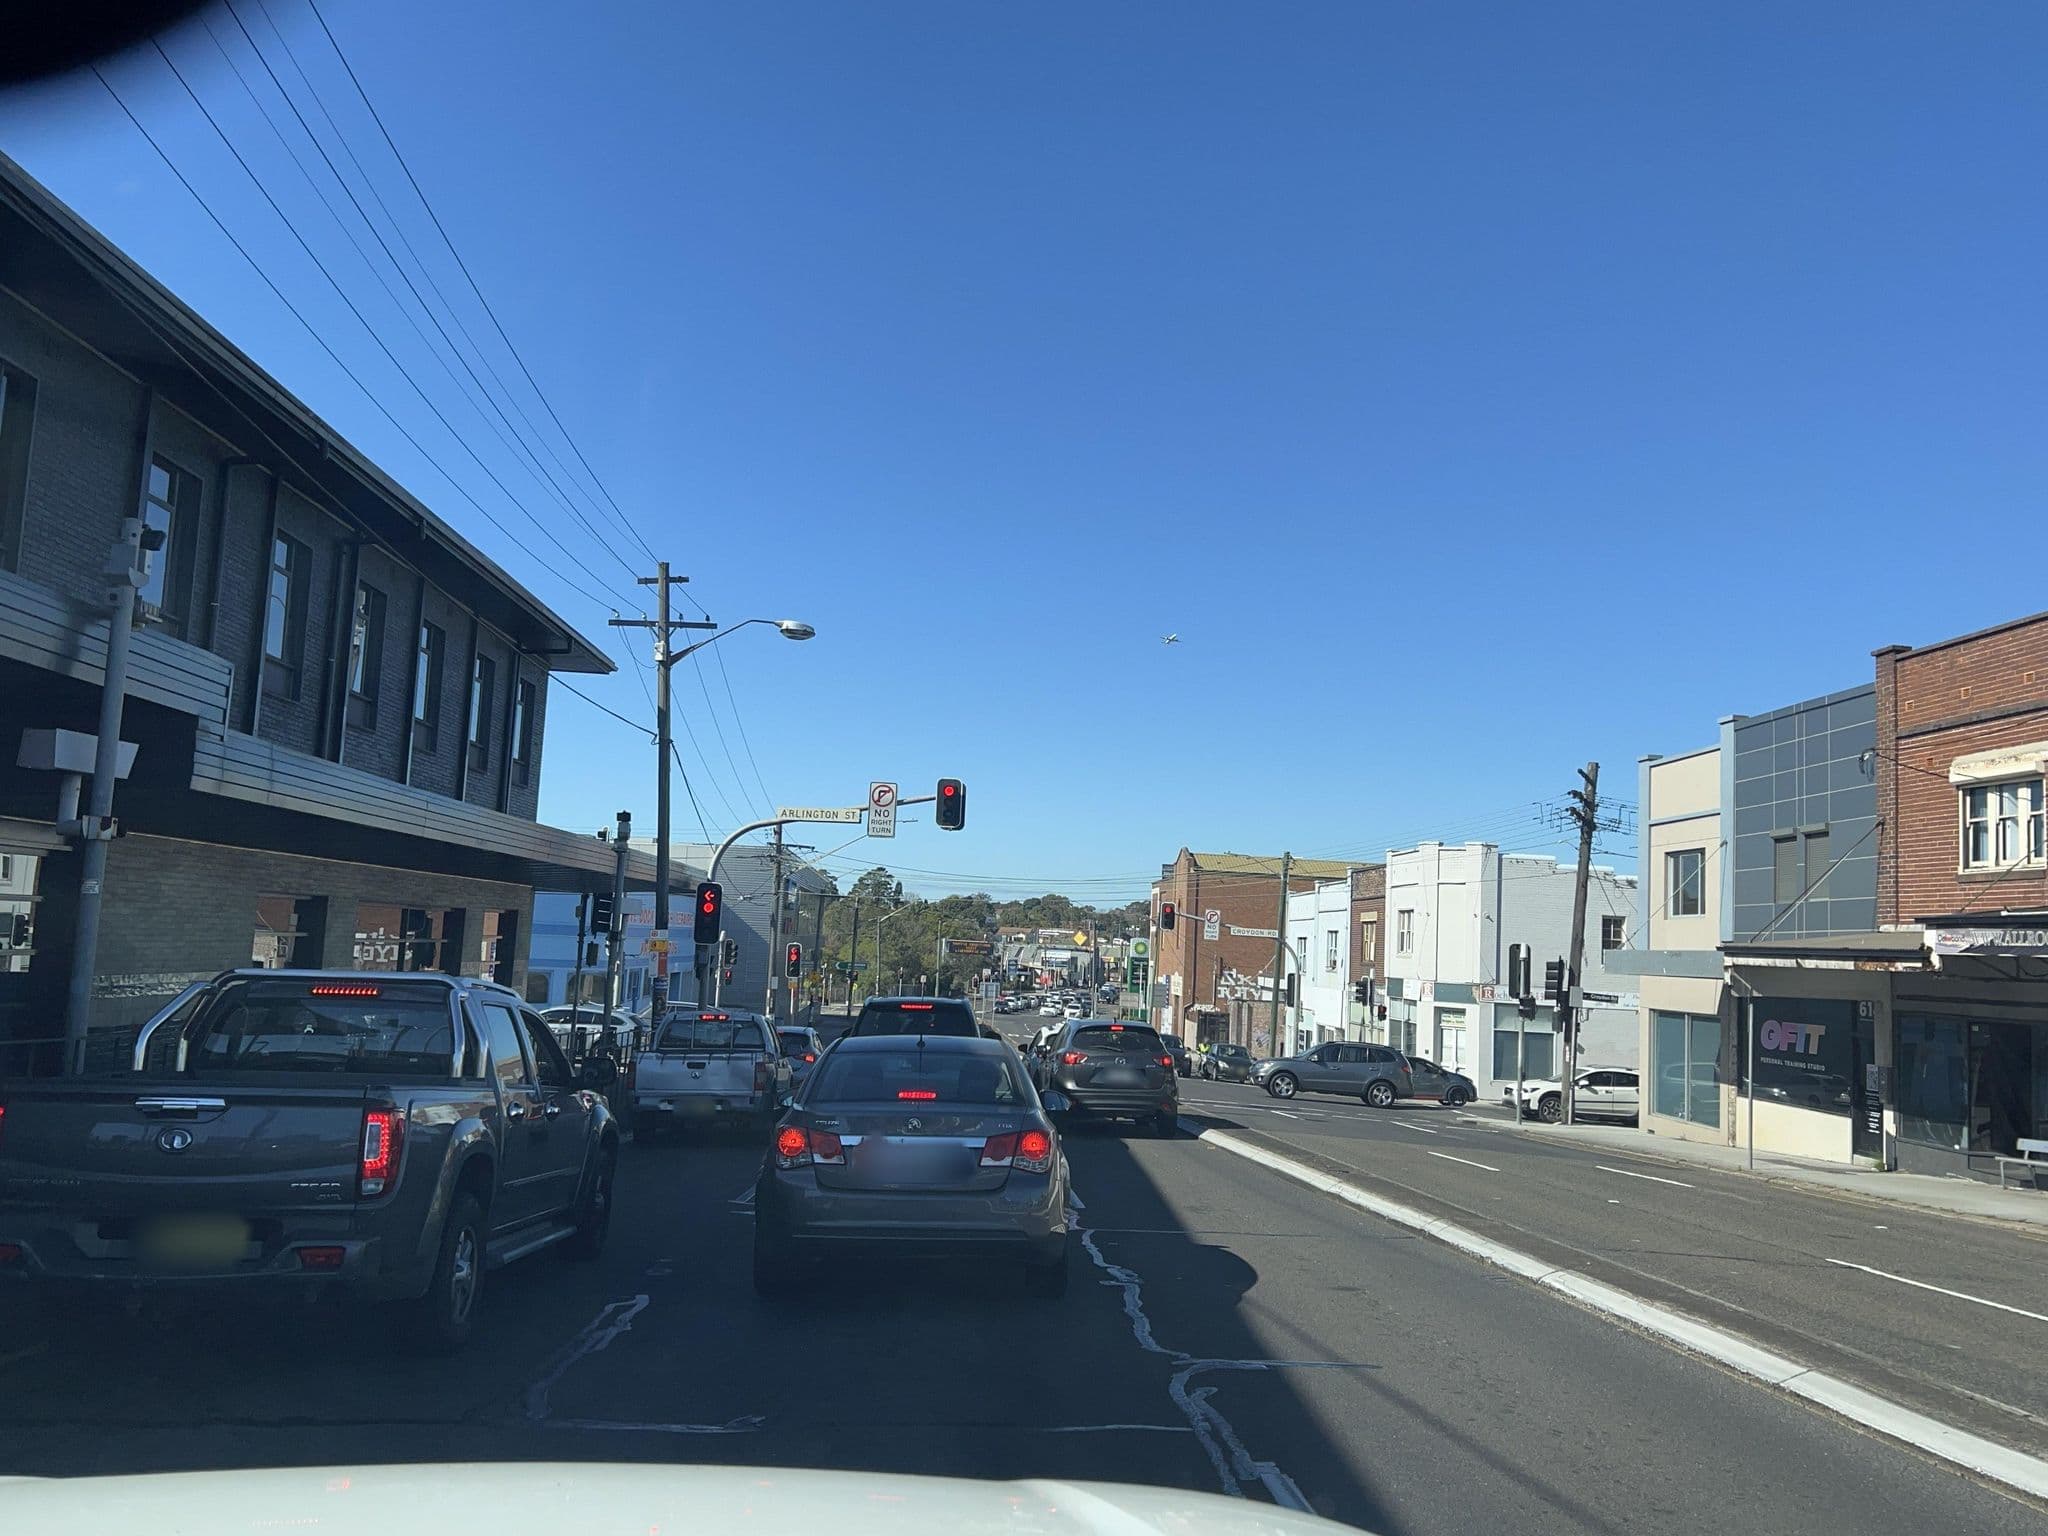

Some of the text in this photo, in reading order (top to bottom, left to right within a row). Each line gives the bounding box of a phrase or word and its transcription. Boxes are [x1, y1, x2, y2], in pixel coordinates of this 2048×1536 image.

[781, 809, 857, 820] ARLINGTON ST
[874, 809, 890, 818] NO
[871, 826, 892, 834] TURN
[1232, 928, 1277, 937] CROYDON RD
[1760, 1019, 1826, 1055] GFIT
[1760, 1056, 1826, 1072] PERSONAL TRAINING STUDIO
